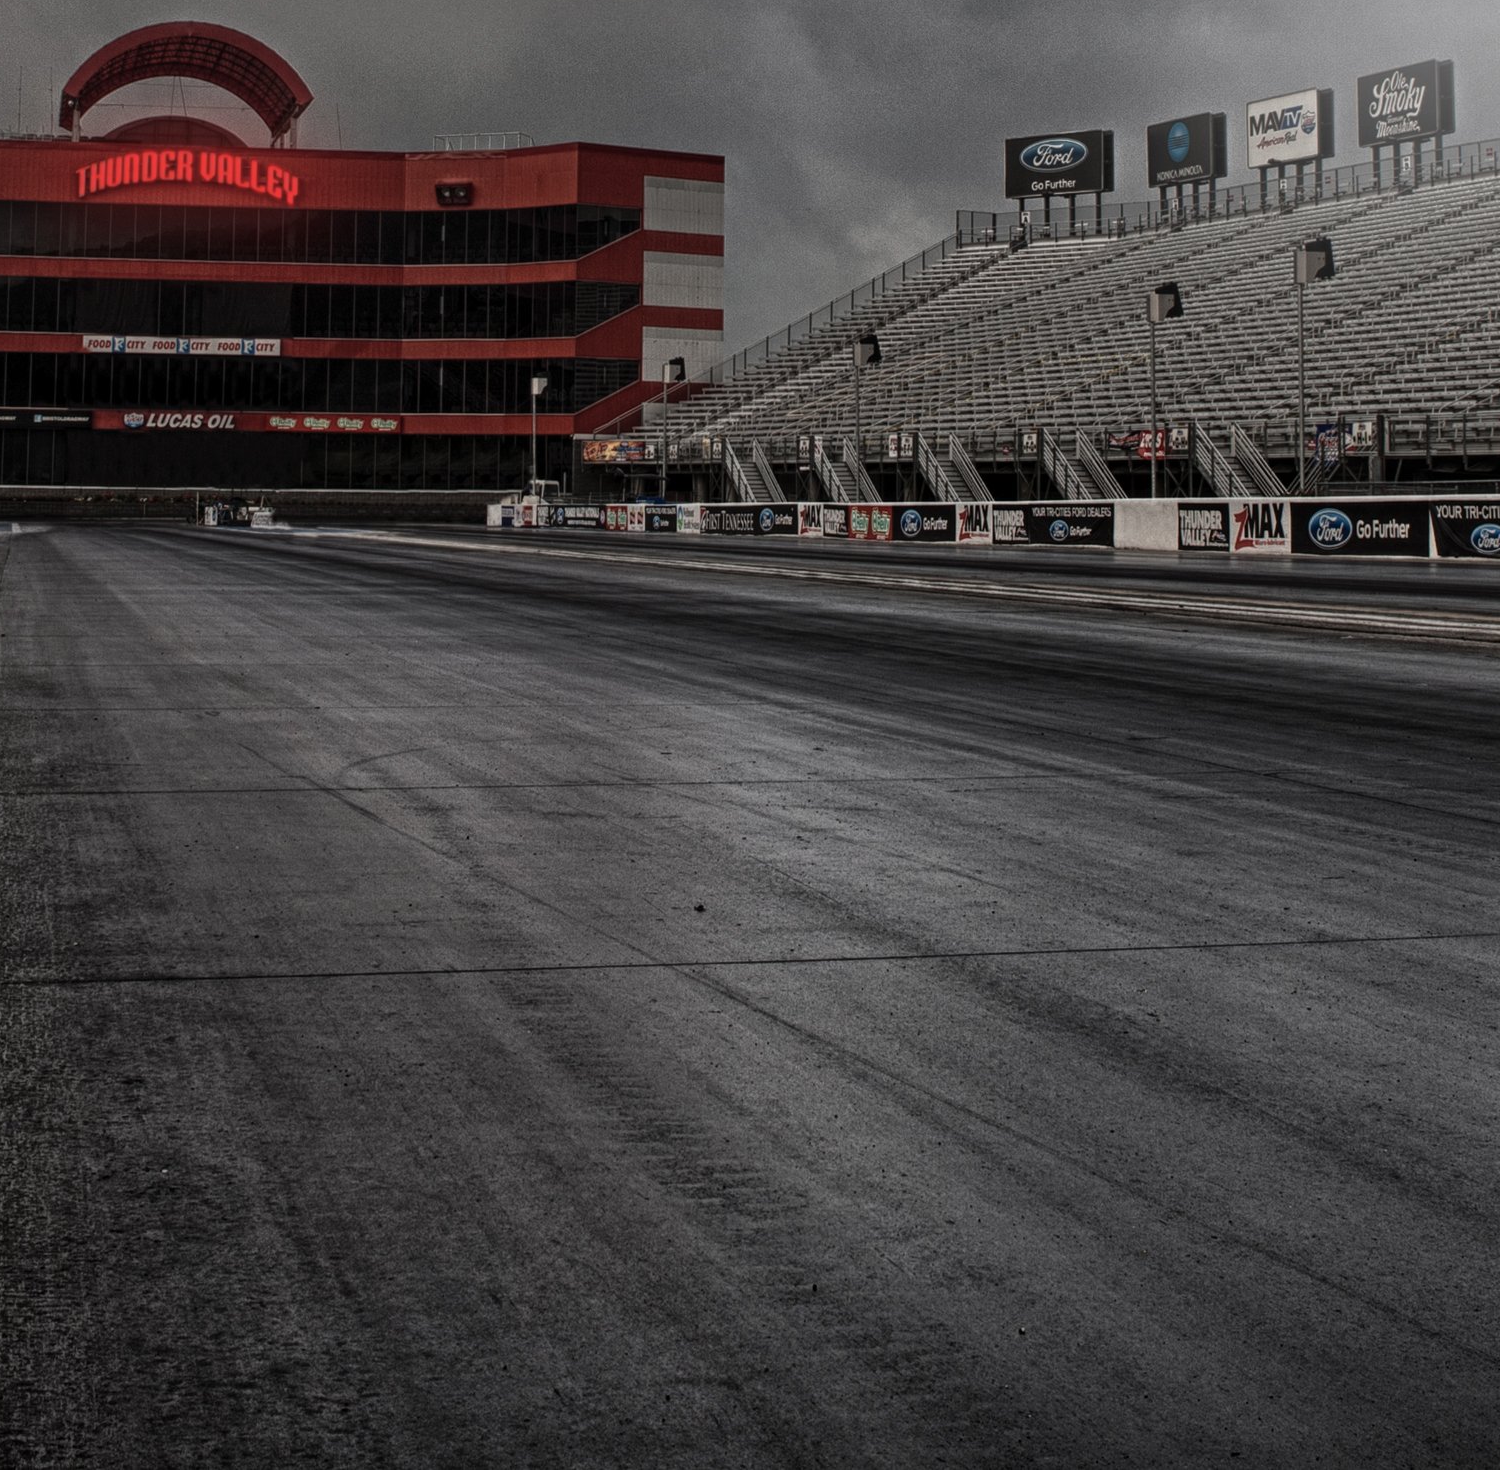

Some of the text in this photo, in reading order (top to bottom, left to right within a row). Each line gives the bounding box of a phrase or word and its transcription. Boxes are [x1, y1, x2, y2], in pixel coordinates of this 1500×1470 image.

[1391, 71, 1409, 90] Ole
[1369, 77, 1426, 118] Smoky
[1250, 105, 1303, 137] MAVTV
[1376, 118, 1420, 138] Moonshine
[1033, 143, 1075, 167] Ford
[76, 149, 299, 206] THUNDER VALLEY
[1157, 165, 1204, 182] KONICA MINOLTA
[1031, 178, 1076, 191] Go Further
[88, 338, 111, 348] FOOD
[126, 340, 146, 349] CITY
[152, 340, 175, 350] FOOD
[191, 341, 210, 351] CITY
[217, 341, 240, 351] FOOD
[256, 342, 275, 352] CITY
[146, 413, 204, 428] LUCAS
[207, 414, 235, 429] OIL
[705, 510, 721, 530] FIRST
[721, 510, 754, 531] TENNESSEE
[994, 509, 1025, 528] THUNDER
[1180, 509, 1223, 530] THUNDER
[1436, 505, 1462, 519] YOUR
[904, 513, 948, 532] Ford Go Further
[1317, 514, 1410, 541] Ford Go Further
[994, 526, 1016, 541] VALLEY
[1181, 529, 1212, 547] VALLEY
[1478, 529, 1500, 548] Ford
